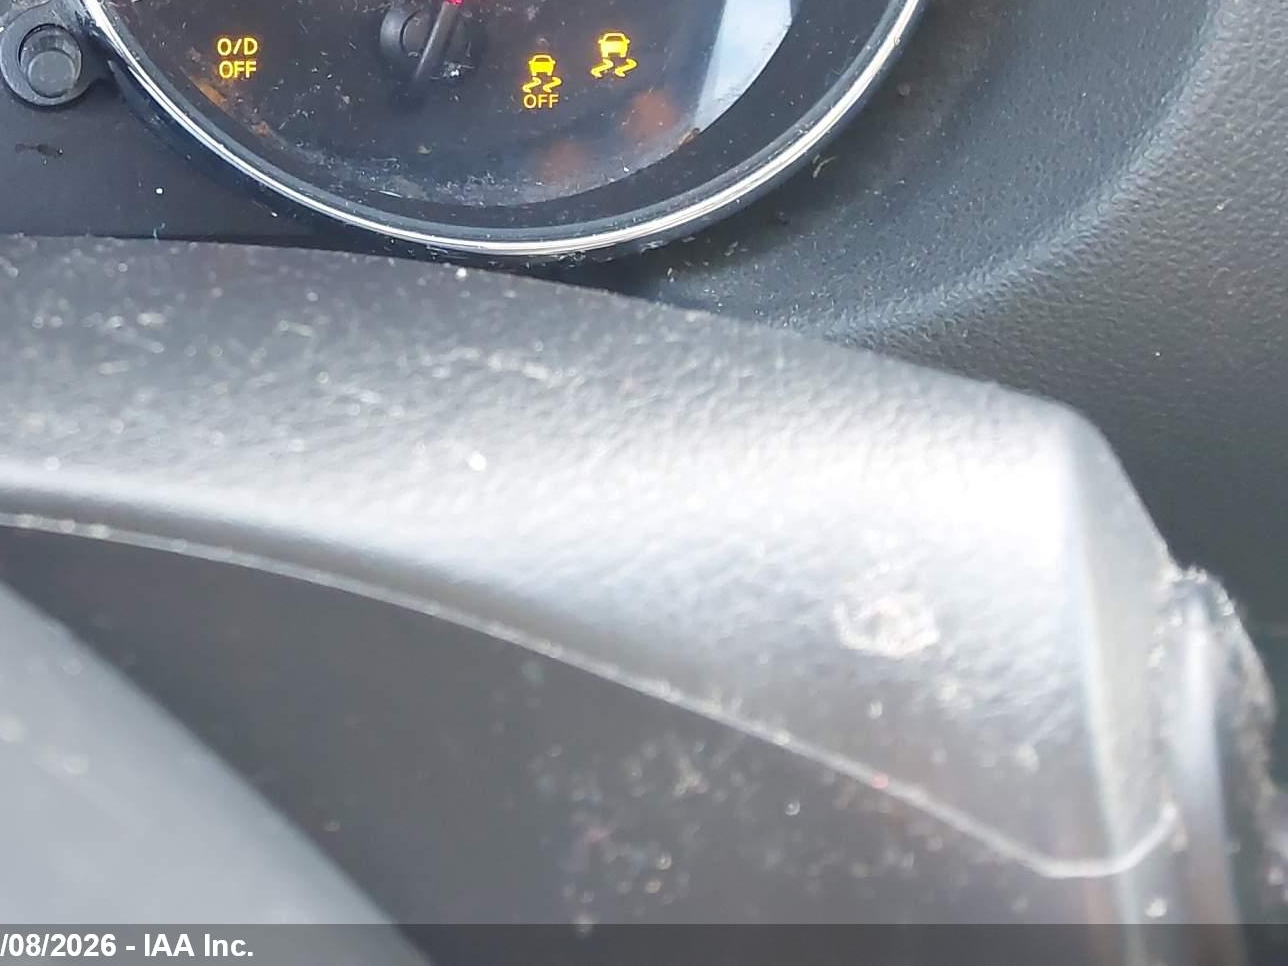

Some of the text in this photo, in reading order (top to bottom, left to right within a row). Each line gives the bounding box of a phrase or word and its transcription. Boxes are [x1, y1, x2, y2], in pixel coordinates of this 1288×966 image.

[217, 37, 258, 57] O/D
[218, 59, 257, 79] OFF
[523, 93, 559, 109] OFF
